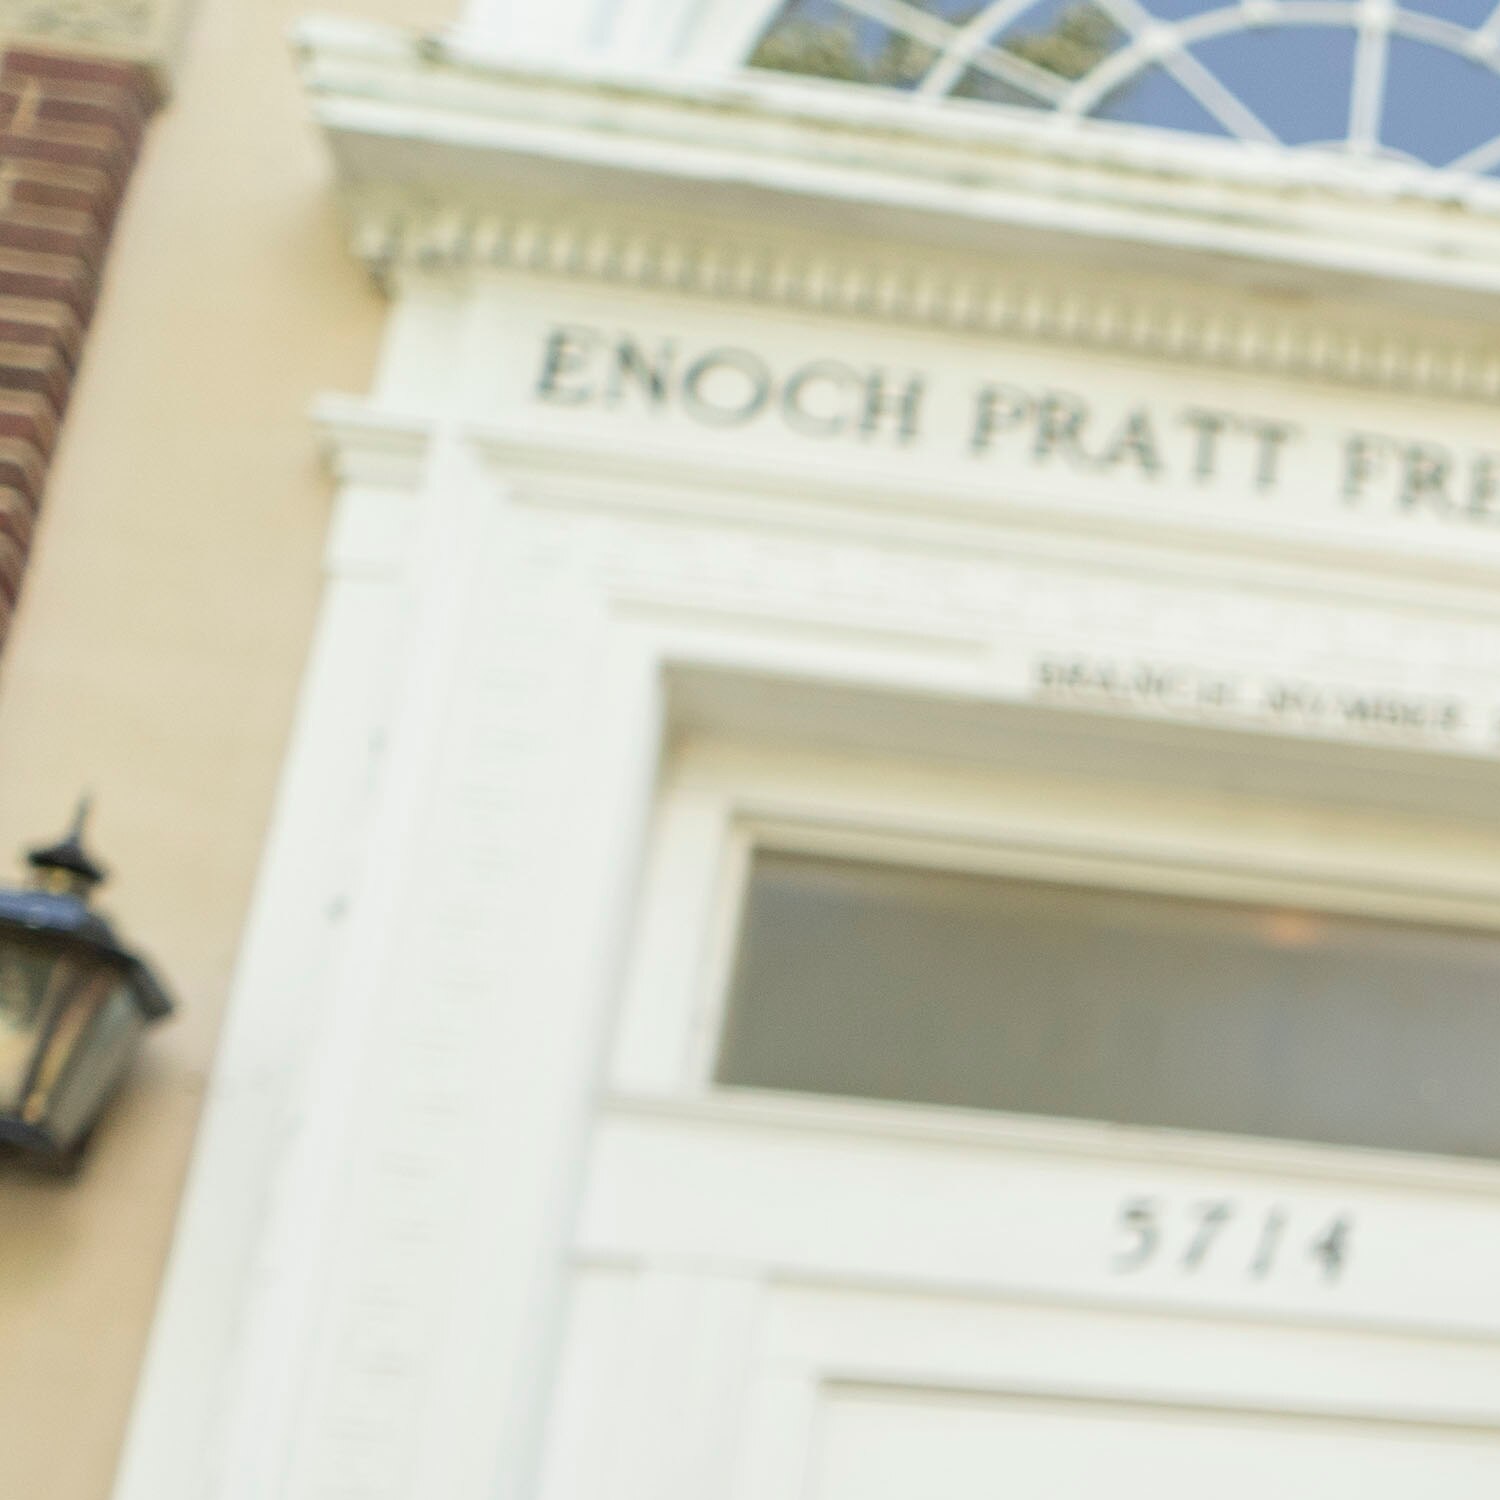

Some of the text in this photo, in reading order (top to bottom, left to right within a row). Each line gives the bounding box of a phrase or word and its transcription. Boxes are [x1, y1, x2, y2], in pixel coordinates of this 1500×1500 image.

[534, 324, 928, 446] ENOCH
[969, 380, 1296, 492] PRATT
[1108, 1195, 1356, 1284] 5714
